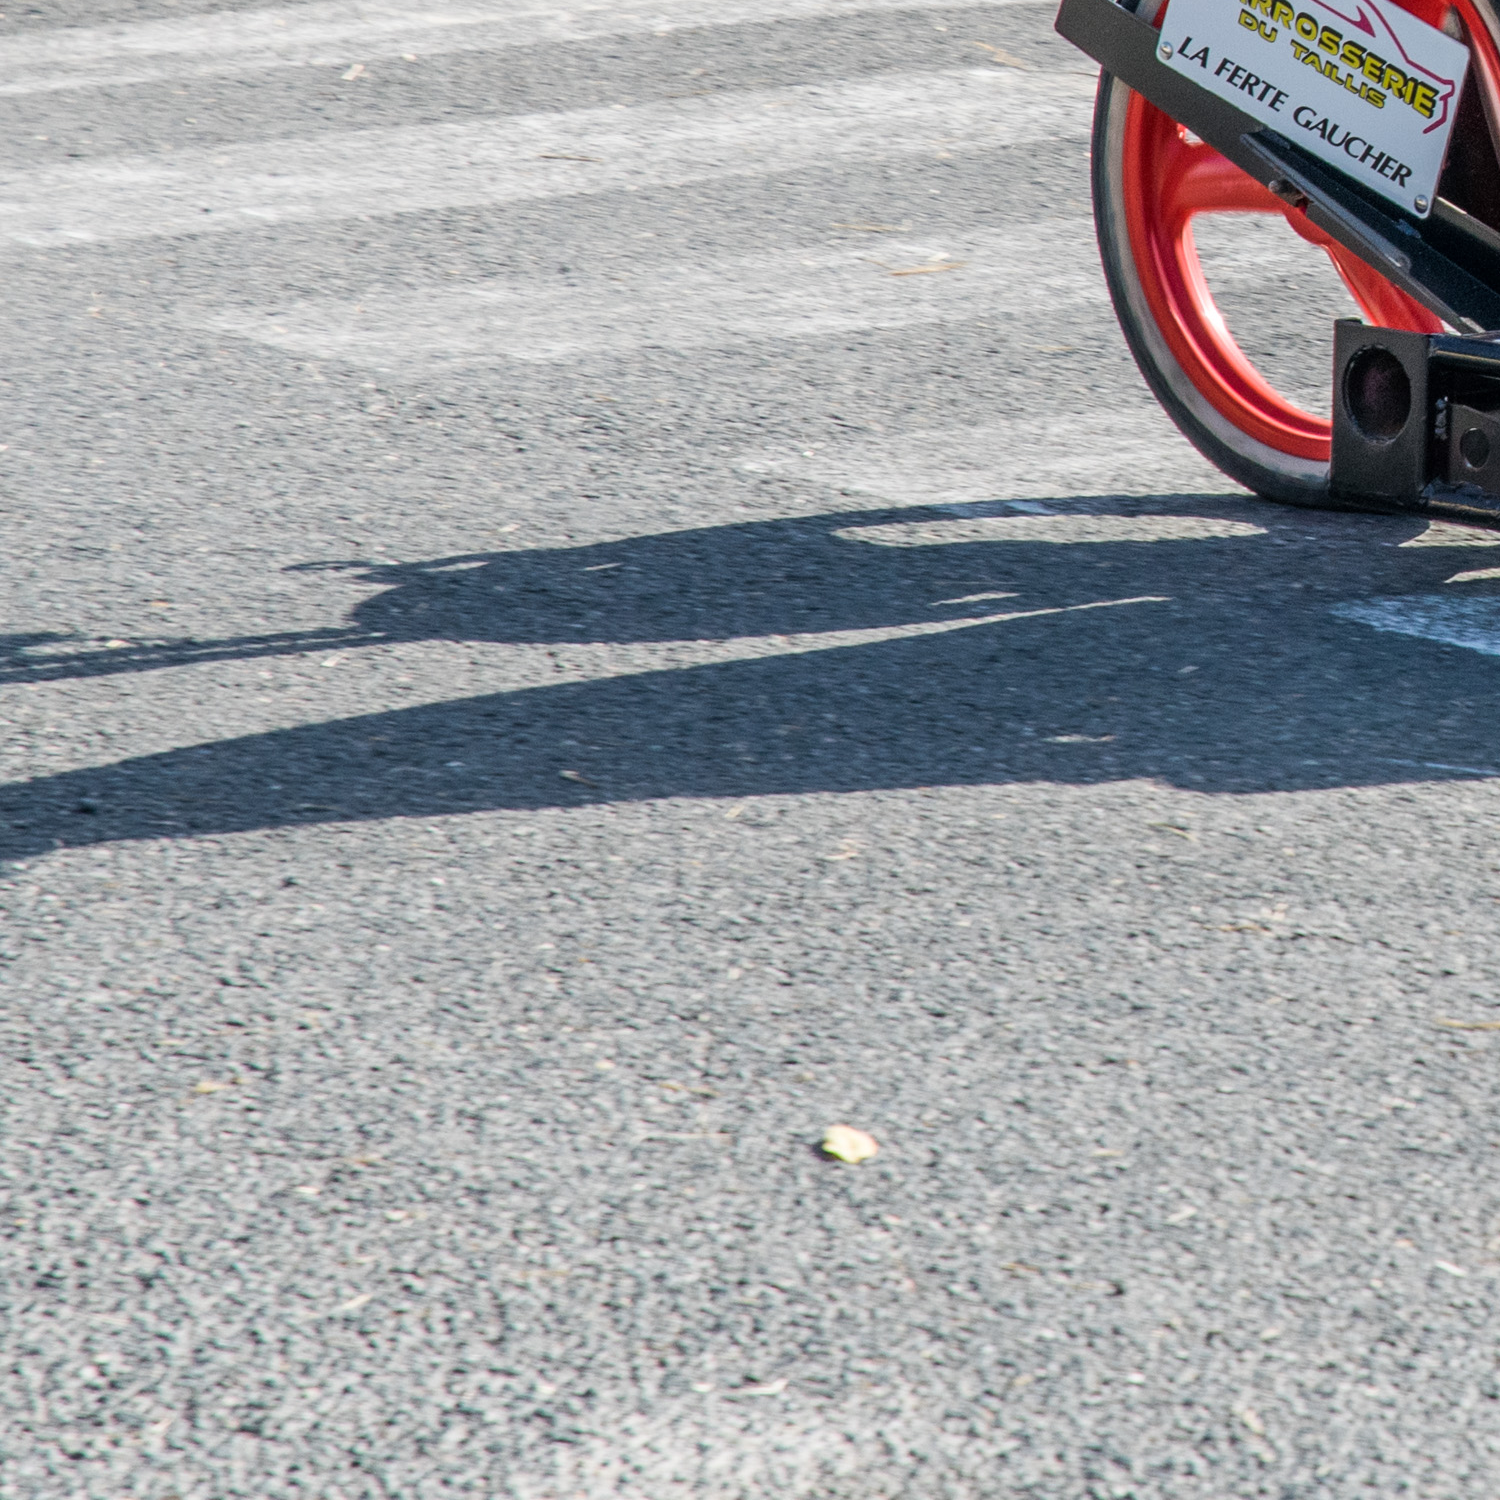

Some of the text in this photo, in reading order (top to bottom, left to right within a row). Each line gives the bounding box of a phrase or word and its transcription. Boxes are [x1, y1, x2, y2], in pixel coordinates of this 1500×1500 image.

[1177, 36, 1413, 188] LA FERTE GAUCHER
[1238, 9, 1387, 109] DU TAILLIS
